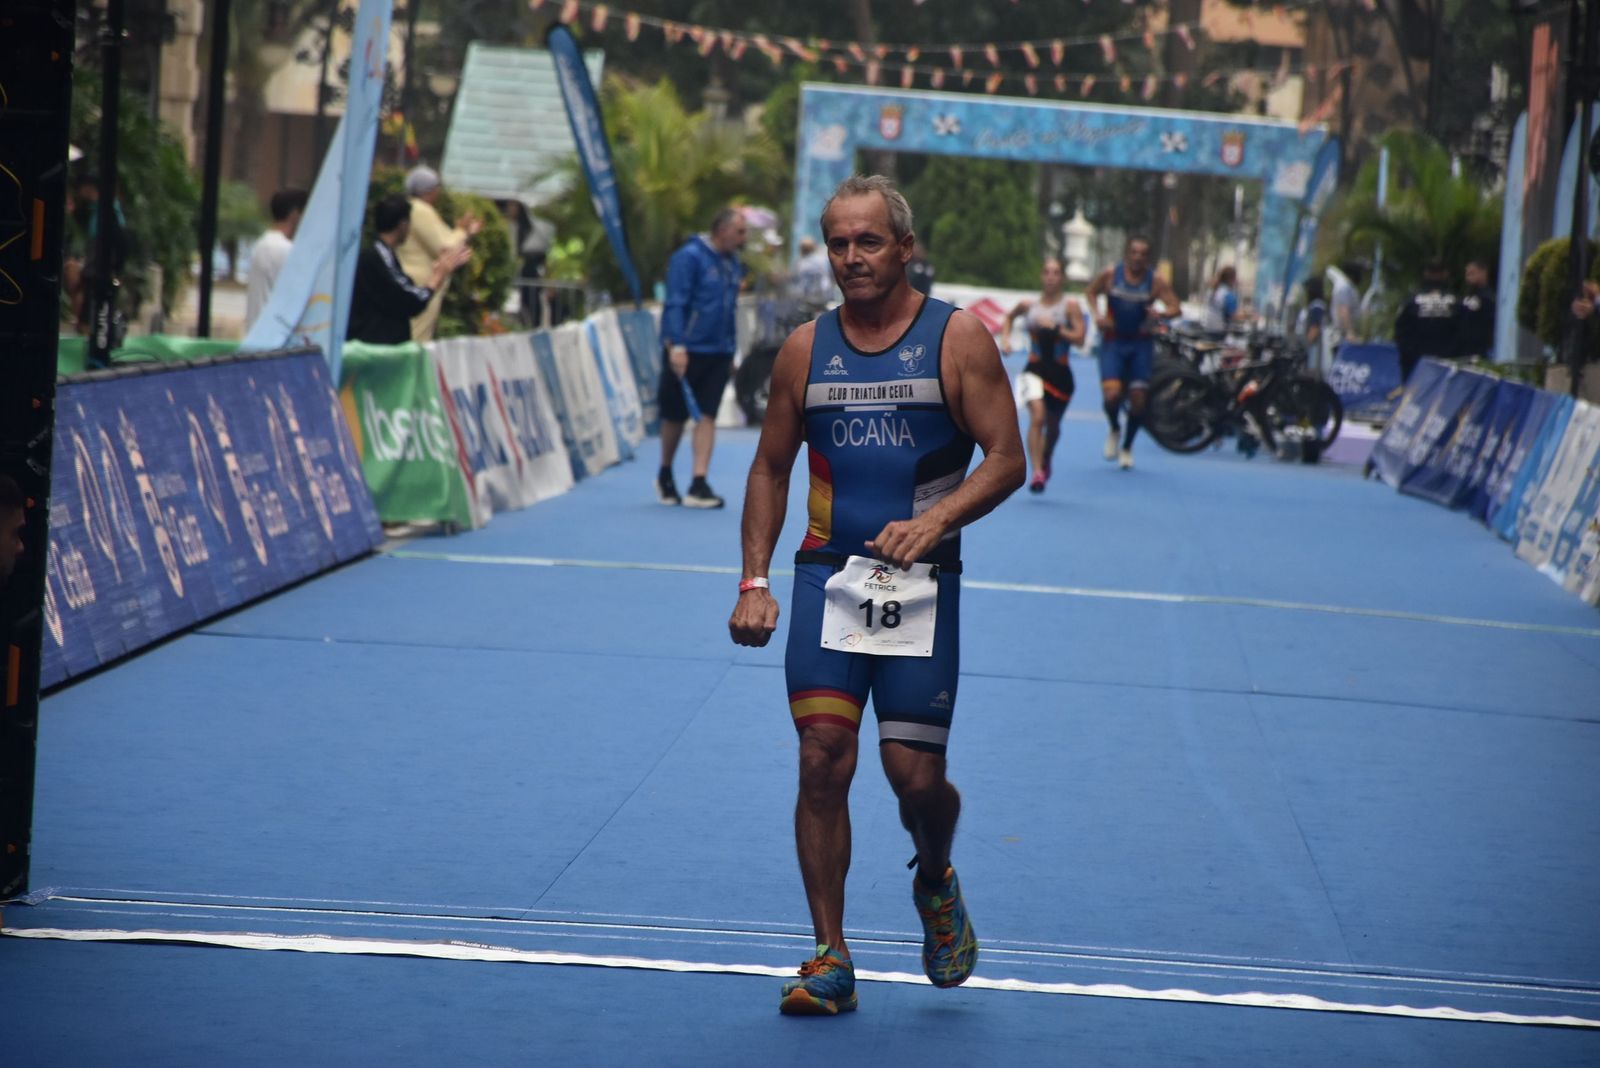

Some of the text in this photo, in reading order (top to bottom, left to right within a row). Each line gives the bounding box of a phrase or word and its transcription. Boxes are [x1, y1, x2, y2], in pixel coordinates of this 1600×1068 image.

[828, 384, 914, 401] CLUB TRIATLÓN CEUTA
[831, 412, 916, 448] OCAÑA
[863, 582, 897, 592] FETRICE
[858, 598, 902, 629] 18
